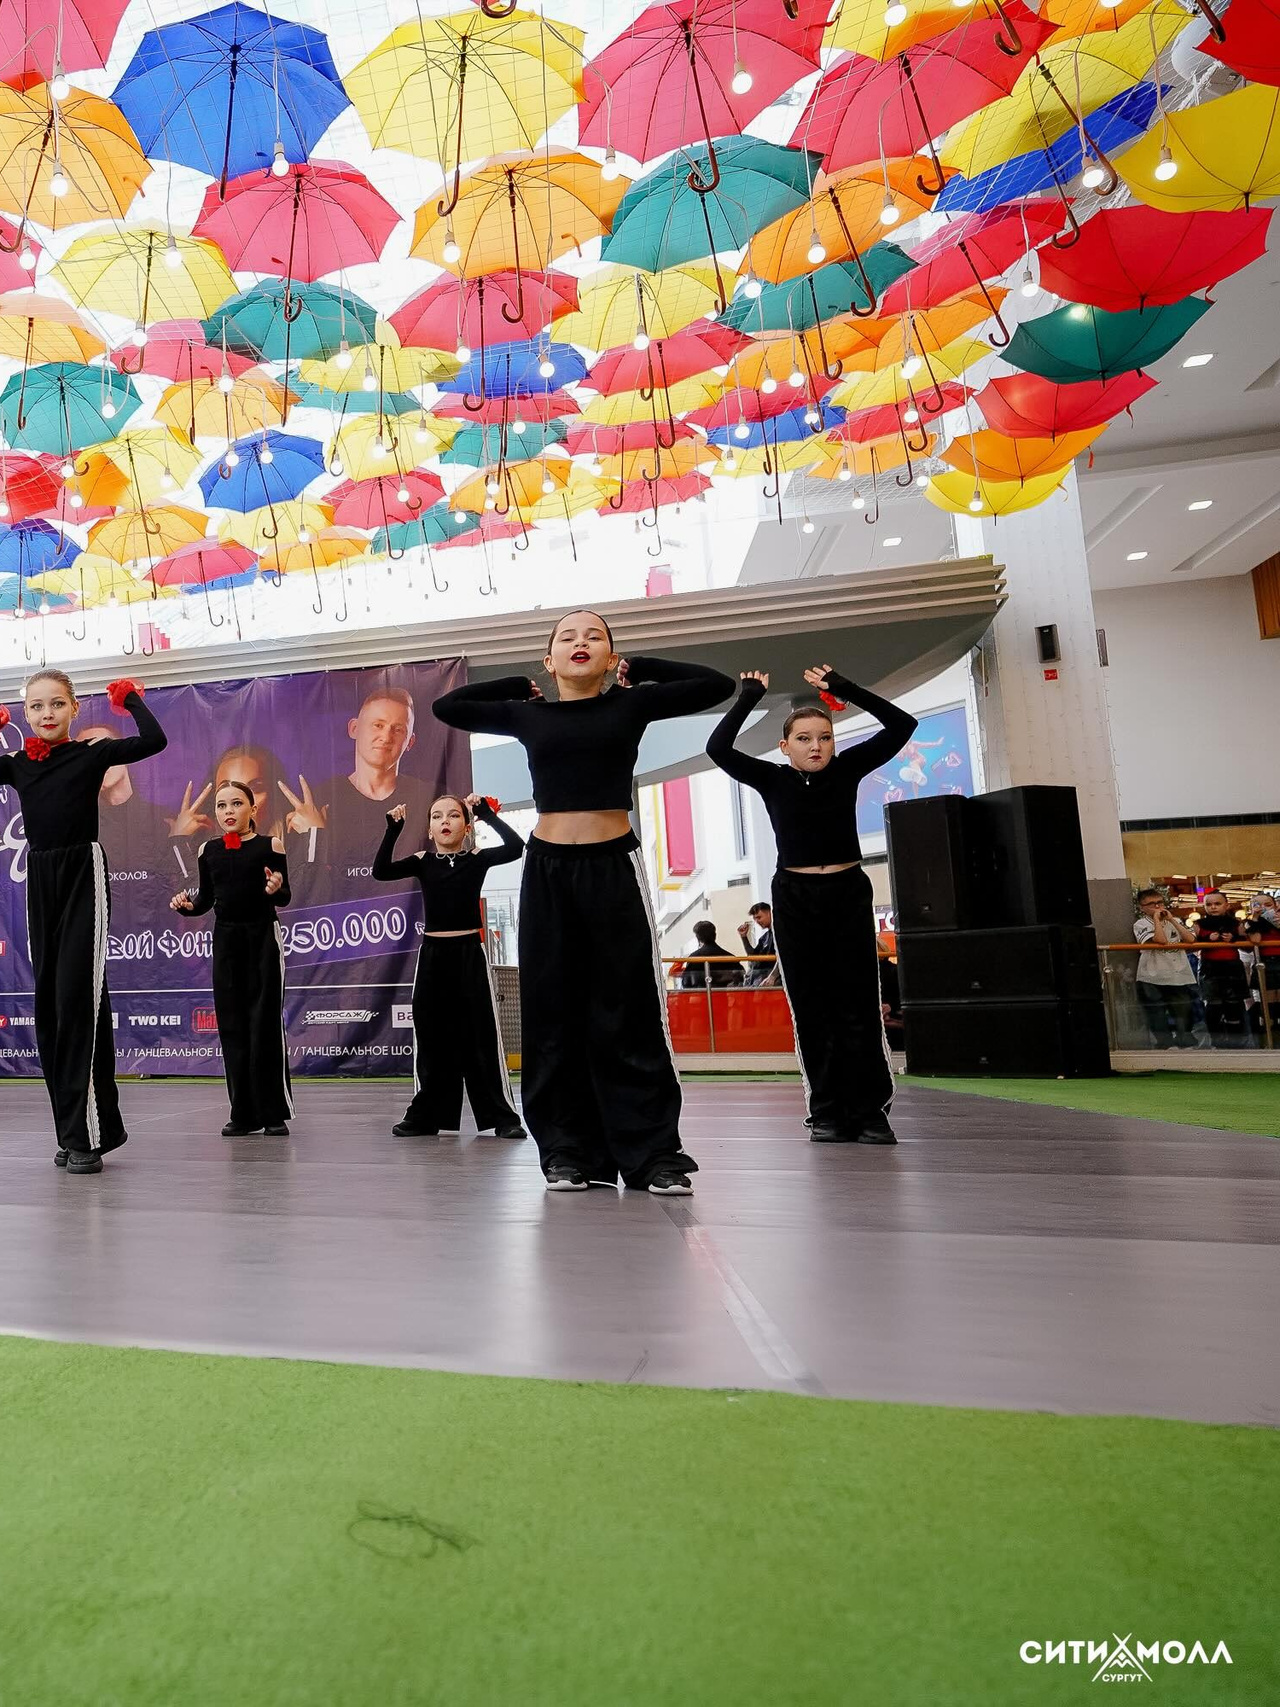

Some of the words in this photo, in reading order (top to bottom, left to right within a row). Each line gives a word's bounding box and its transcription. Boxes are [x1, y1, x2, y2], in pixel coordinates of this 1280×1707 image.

[280, 907, 407, 957] 250.000
[128, 1015, 158, 1026] TWO
[160, 1015, 181, 1026] KEI
[134, 1047, 213, 1058] ТАНЦЕВАЛЬНОЕ
[301, 1046, 389, 1057] ТАНЦЕВАЛЬНОЕ
